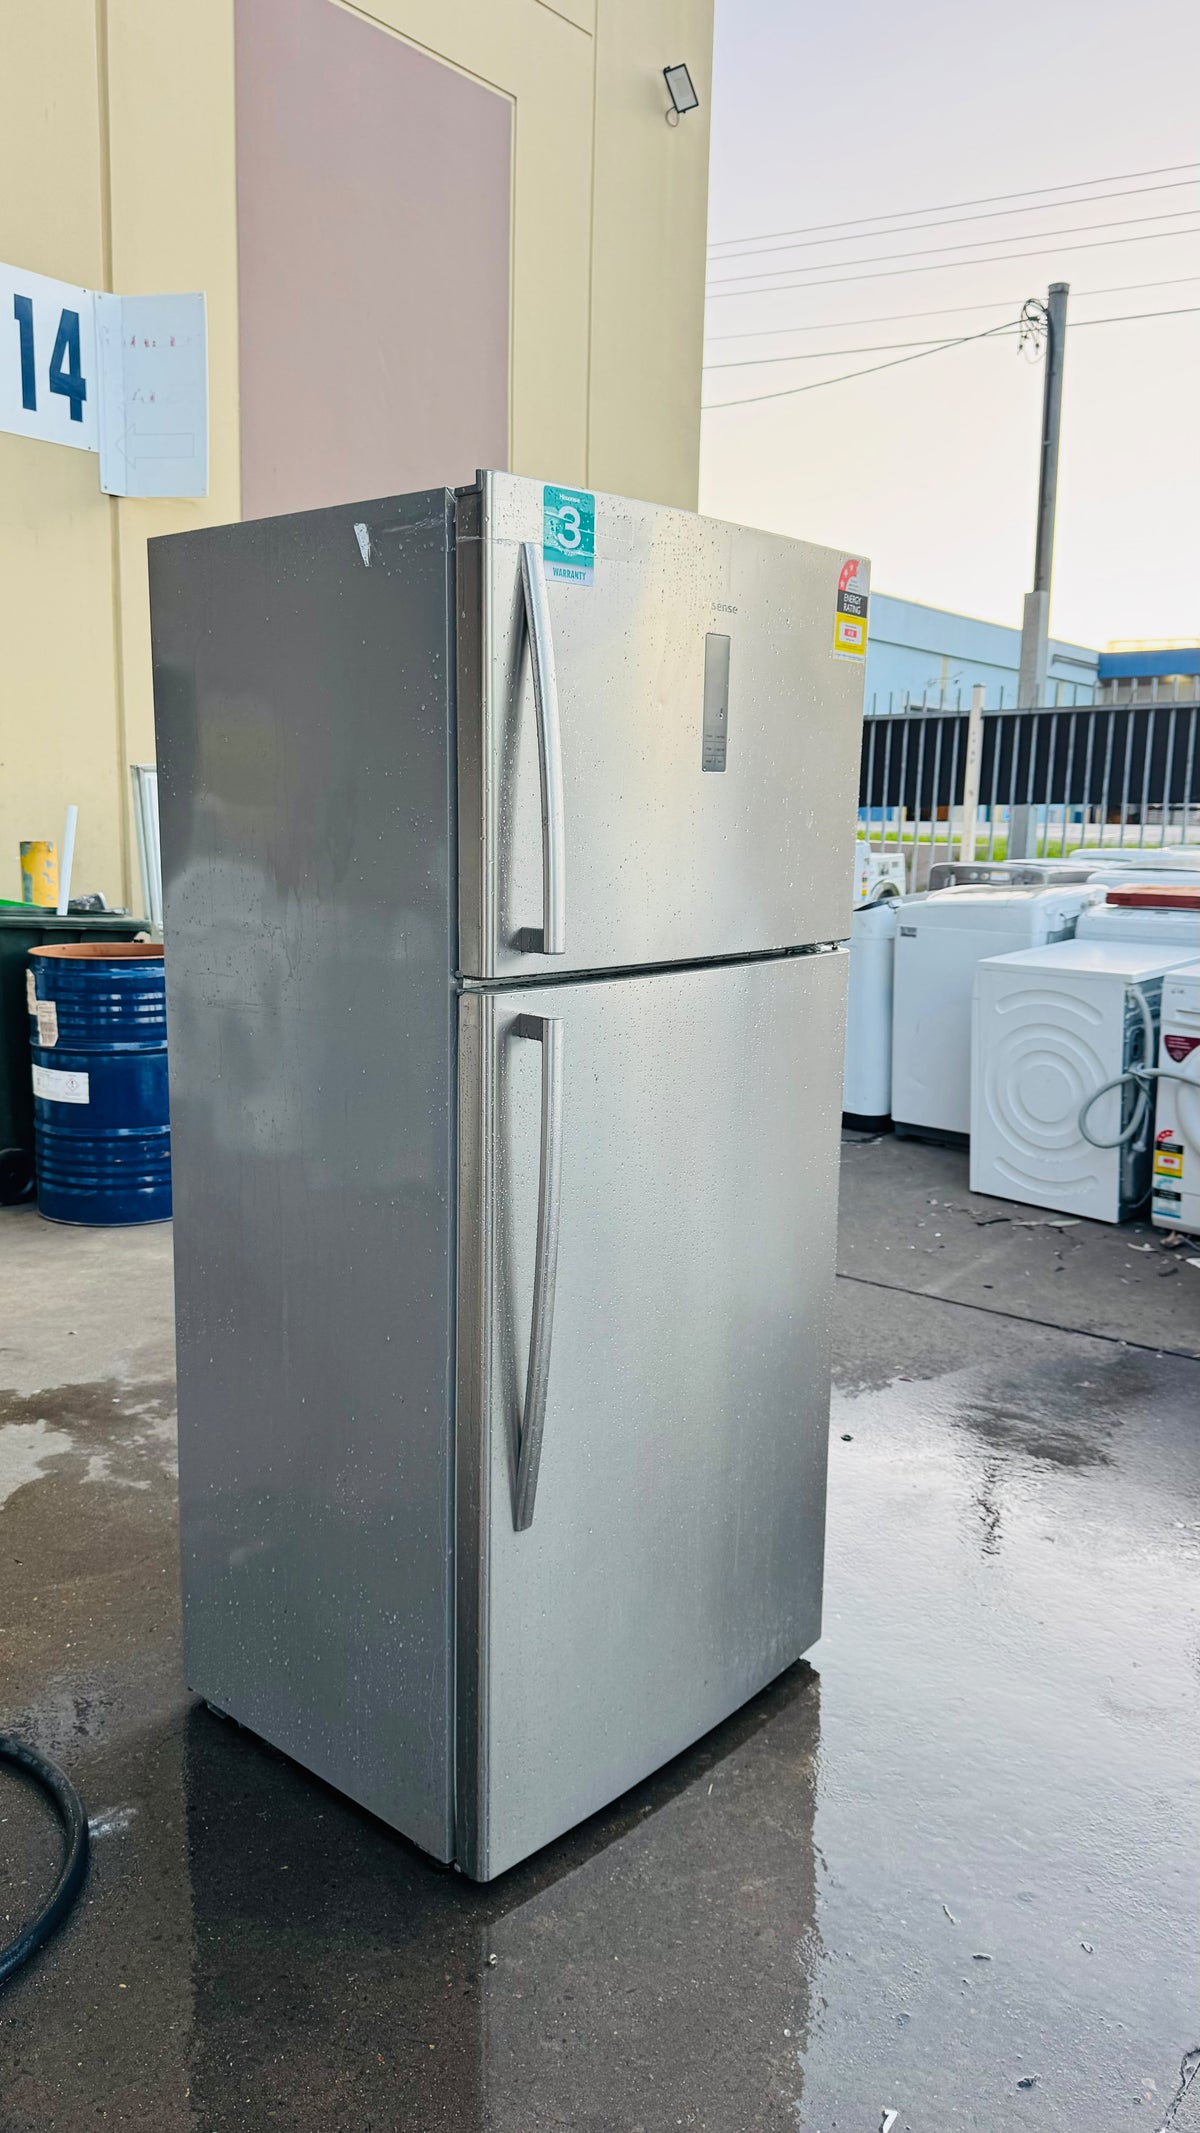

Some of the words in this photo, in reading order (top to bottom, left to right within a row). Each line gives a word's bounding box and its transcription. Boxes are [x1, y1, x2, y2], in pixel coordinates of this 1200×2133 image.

[13, 293, 87, 423] 14
[558, 505, 581, 549] 3
[552, 567, 586, 580] WARRANTY
[843, 593, 861, 604] ENERGY
[843, 603, 860, 614] RATING
